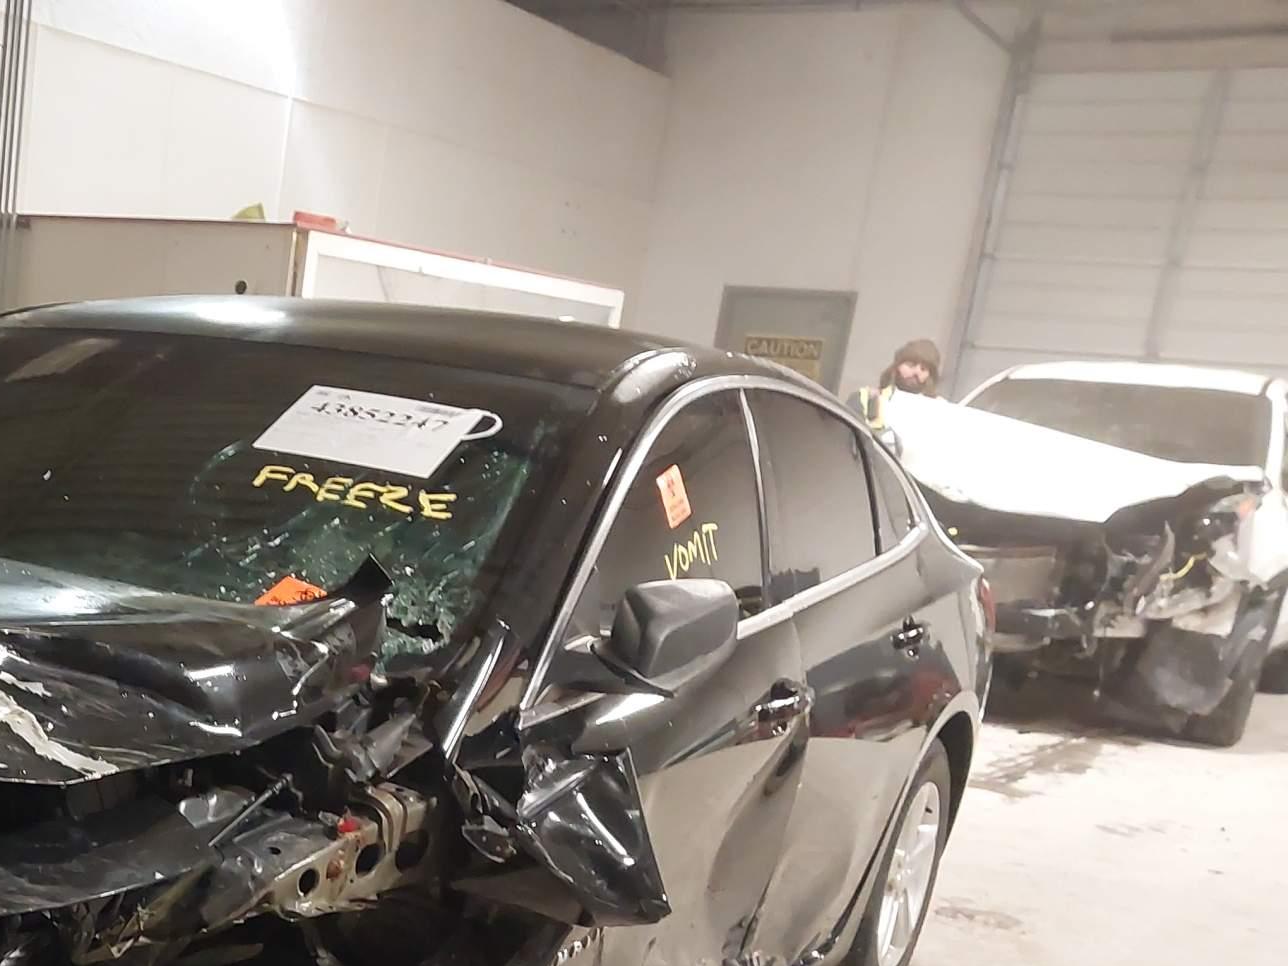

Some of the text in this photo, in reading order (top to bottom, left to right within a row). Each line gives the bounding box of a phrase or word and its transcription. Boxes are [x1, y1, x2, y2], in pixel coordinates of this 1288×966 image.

[746, 339, 819, 358] CAUTION
[252, 464, 458, 520] FREEZE
[663, 522, 719, 581] VOMIT
